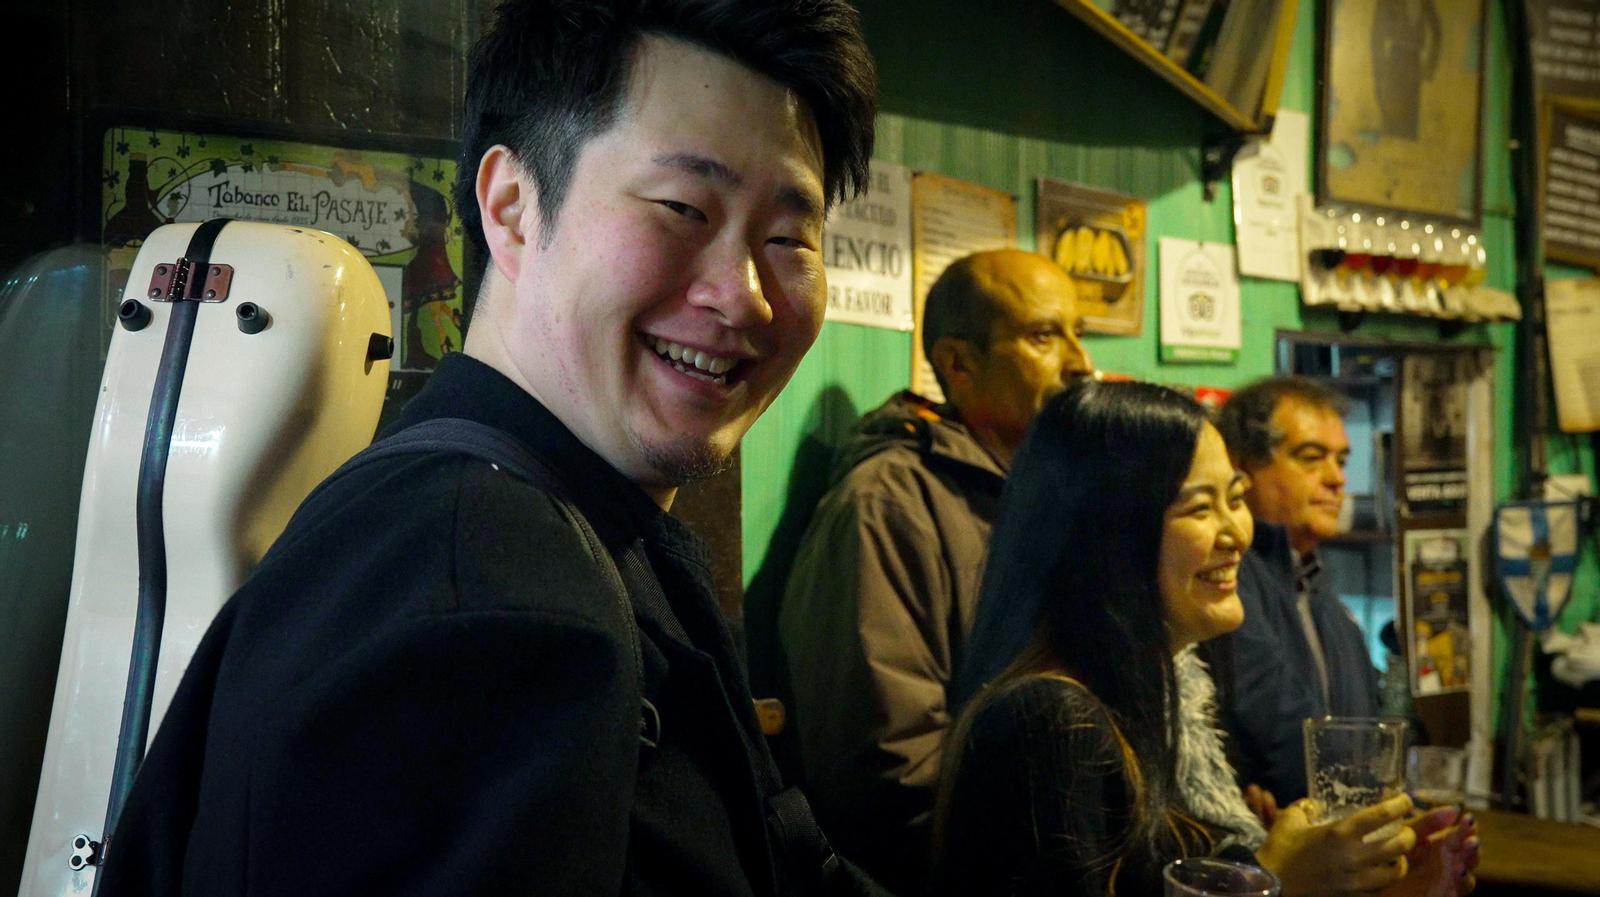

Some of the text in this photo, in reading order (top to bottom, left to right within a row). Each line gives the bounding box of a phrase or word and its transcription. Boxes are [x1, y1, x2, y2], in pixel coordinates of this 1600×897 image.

[208, 180, 388, 230] Tabanco EL PASAJE
[821, 234, 902, 279] LENCIO
